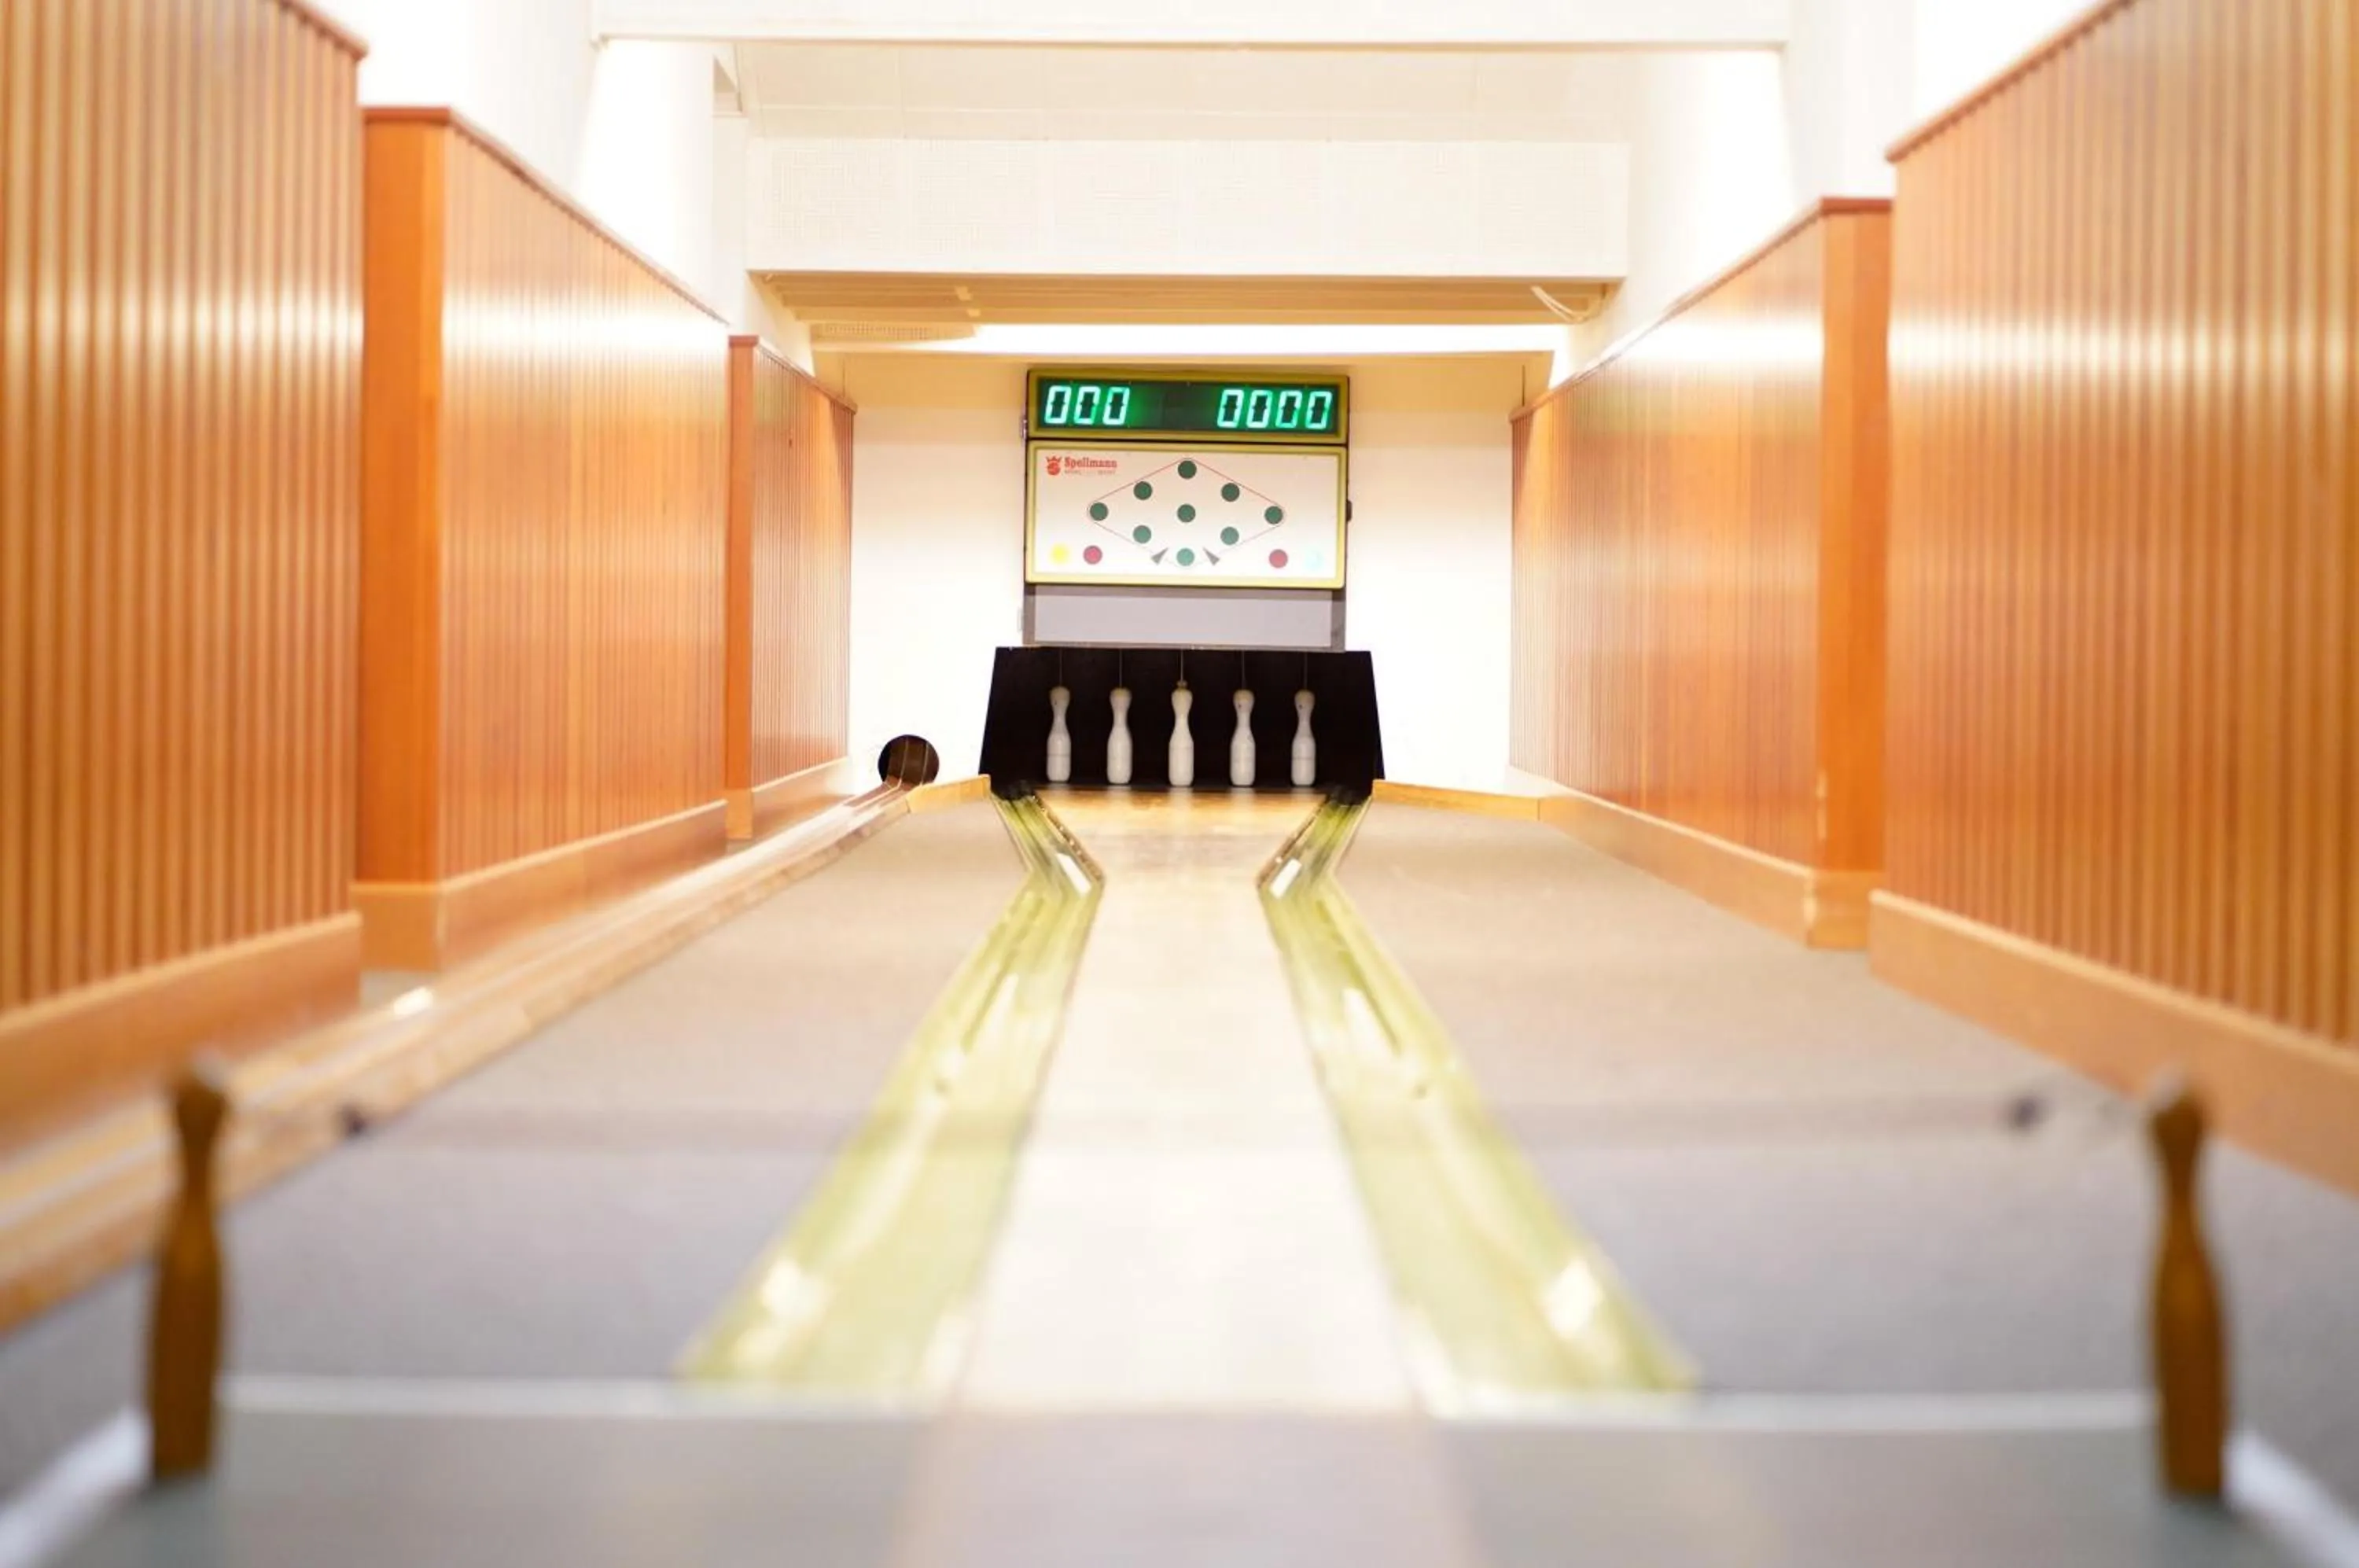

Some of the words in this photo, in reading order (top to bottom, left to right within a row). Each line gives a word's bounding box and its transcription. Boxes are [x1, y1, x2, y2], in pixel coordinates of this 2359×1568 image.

[1044, 385, 1130, 425] 000
[1217, 389, 1332, 429] 0000
[1064, 456, 1117, 469] Spellmann
